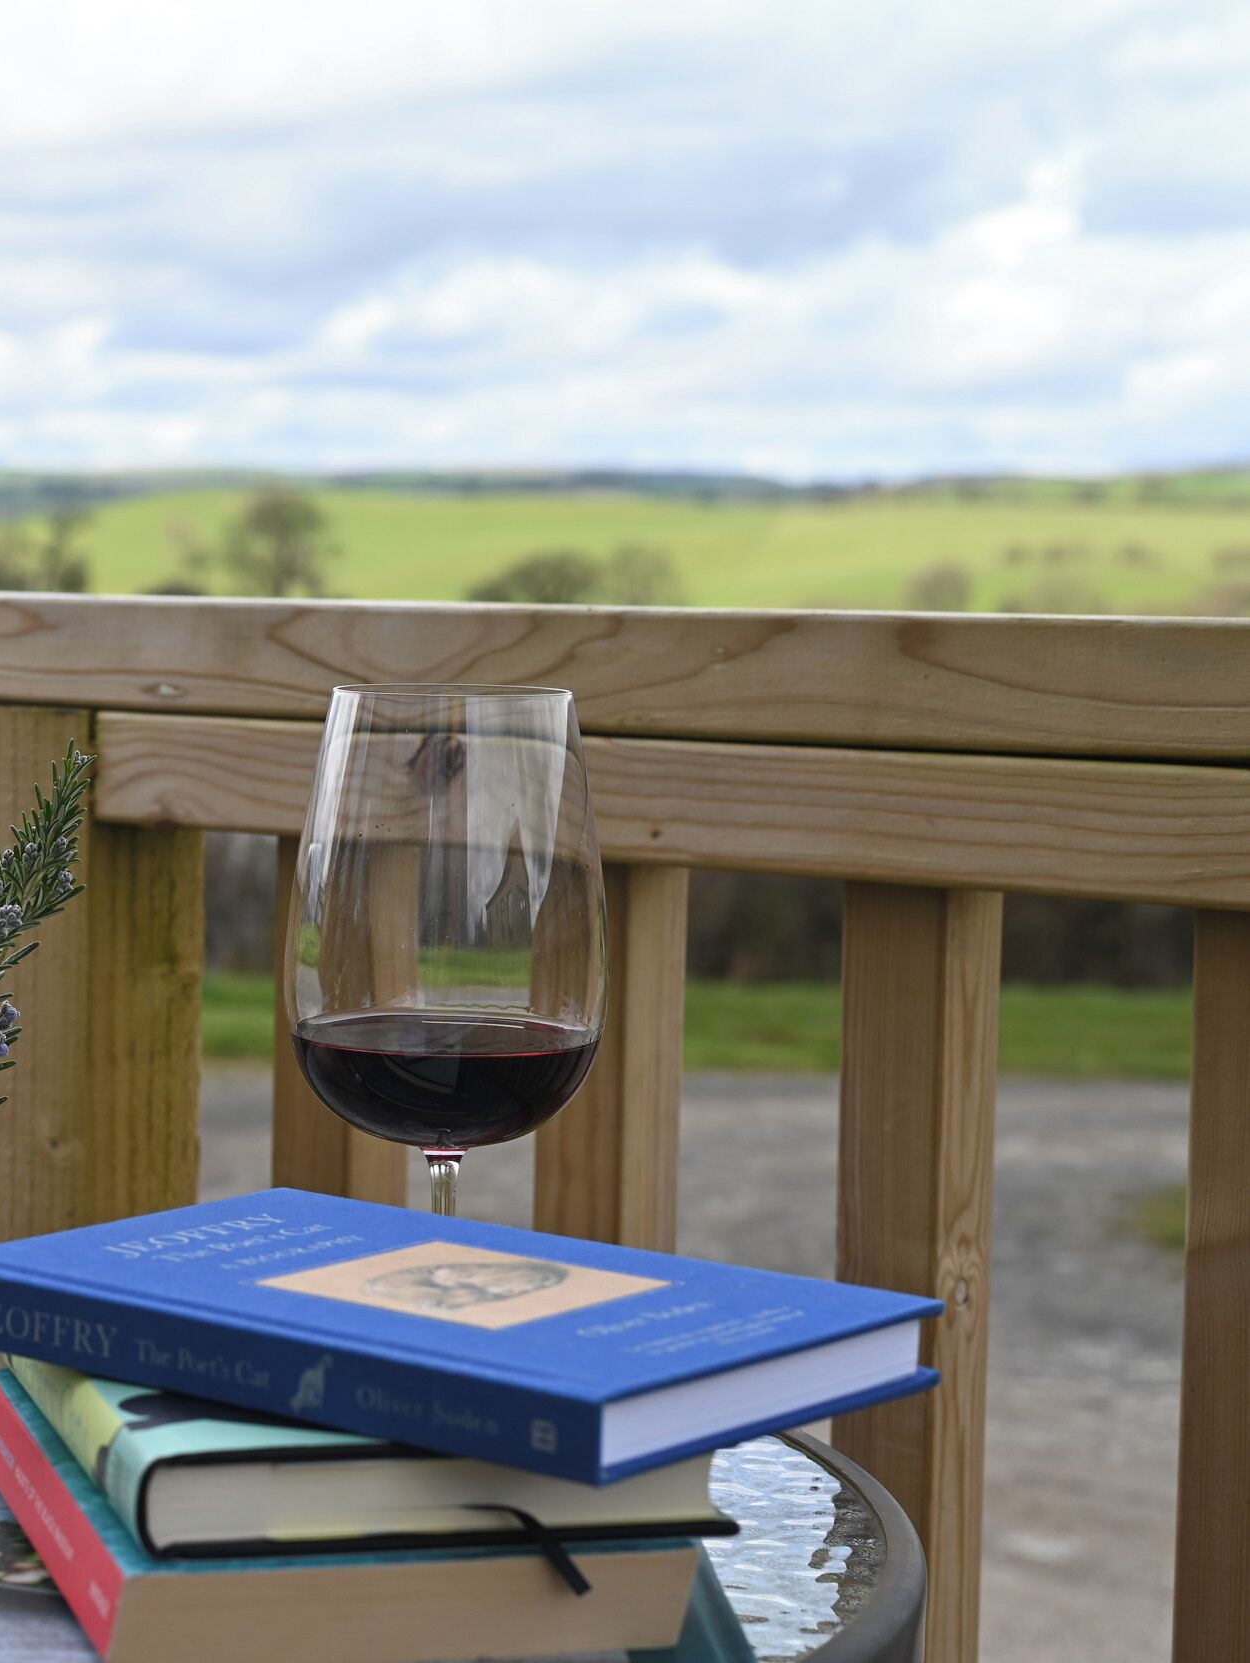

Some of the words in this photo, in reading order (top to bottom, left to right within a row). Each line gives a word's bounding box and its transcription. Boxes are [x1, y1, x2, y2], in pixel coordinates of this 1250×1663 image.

[103, 1212, 283, 1259] JEOFFRY
[278, 1223, 332, 1236] Cat
[134, 1339, 172, 1367] The
[177, 1346, 230, 1377] Poet's
[234, 1360, 271, 1389] Cat
[355, 1386, 422, 1418] Oliver
